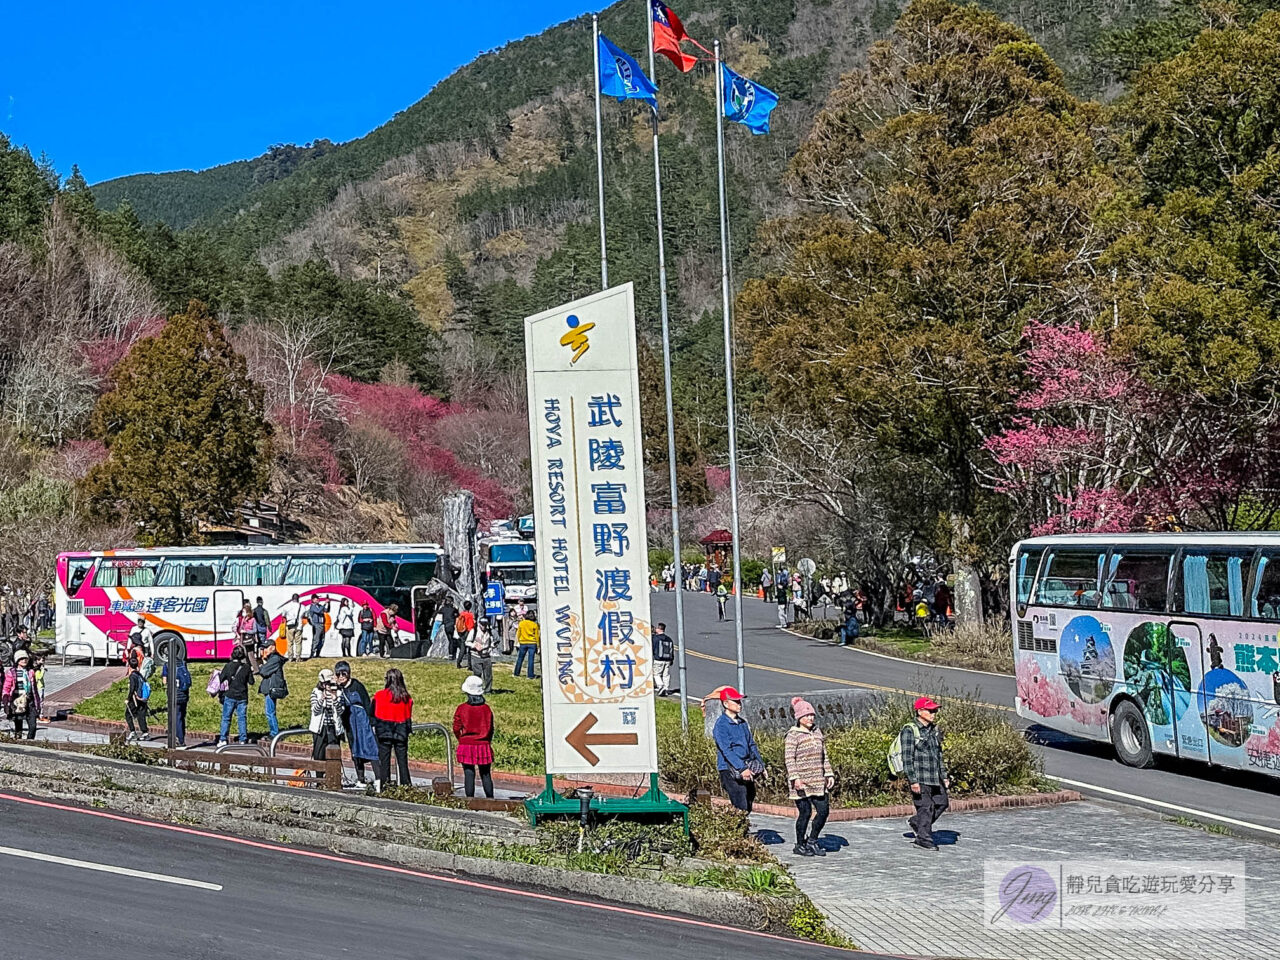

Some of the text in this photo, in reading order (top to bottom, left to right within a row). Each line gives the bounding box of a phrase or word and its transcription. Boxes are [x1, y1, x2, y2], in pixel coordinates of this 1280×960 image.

[544, 398, 562, 450] HOYA
[547, 457, 567, 529] RESORT
[551, 537, 570, 596] HOTEL
[587, 392, 636, 689] 武陵富野渡假村
[1234, 643, 1280, 675] 熊本
